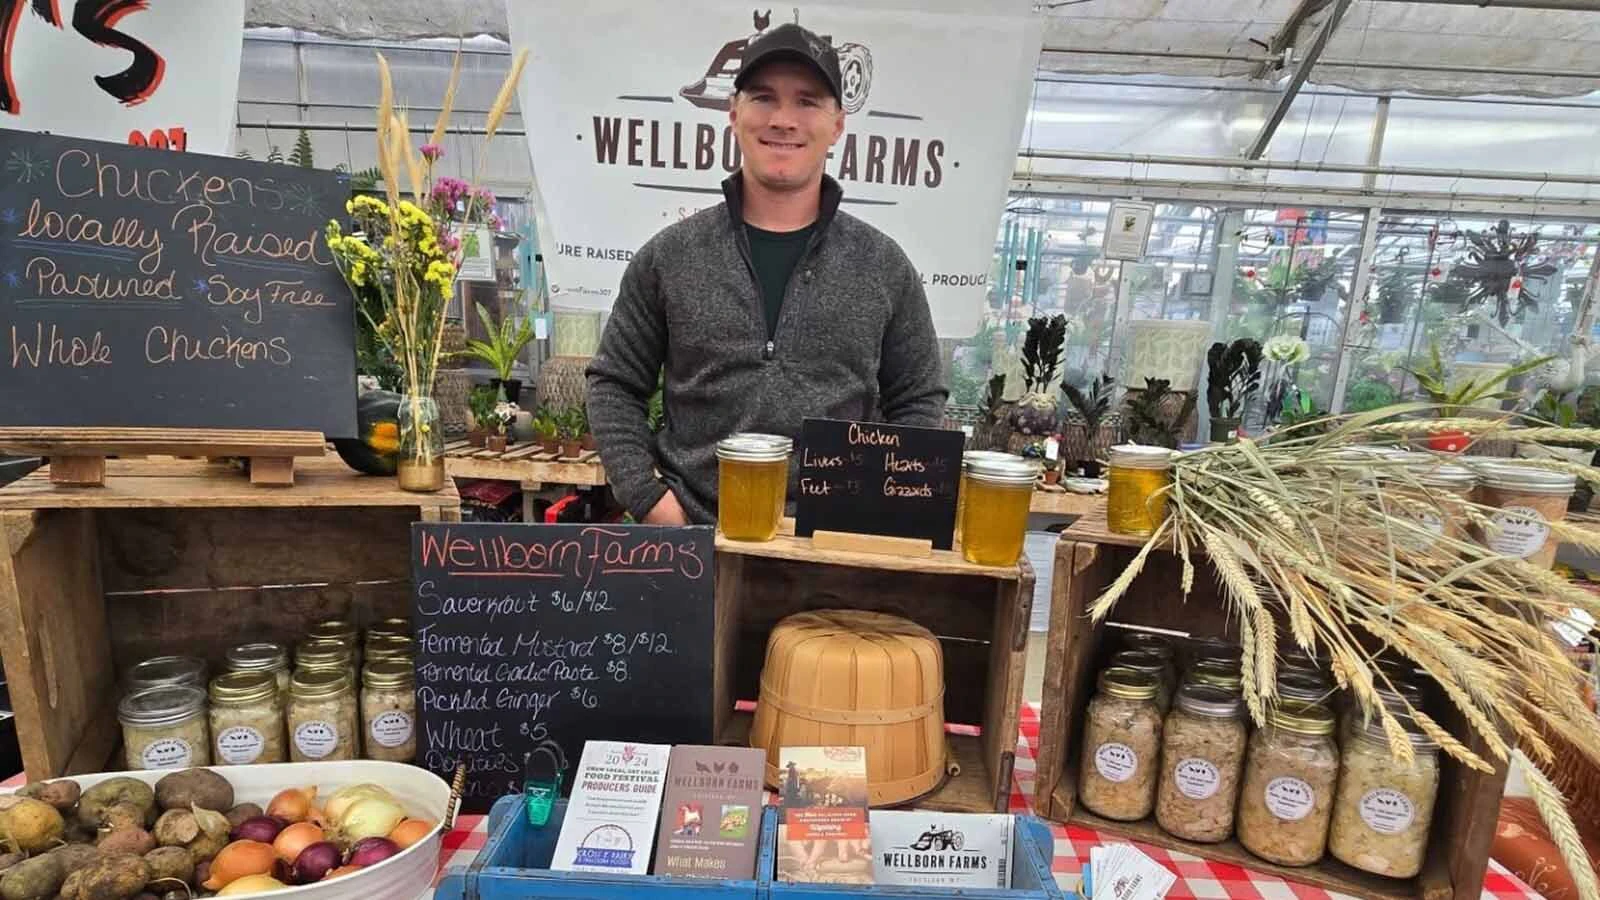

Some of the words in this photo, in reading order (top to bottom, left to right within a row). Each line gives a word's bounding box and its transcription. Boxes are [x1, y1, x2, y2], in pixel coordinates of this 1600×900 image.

[593, 116, 743, 173] WELLBO
[56, 149, 285, 210] Chickens
[18, 200, 164, 273] locally
[172, 204, 333, 266] Raised
[587, 246, 632, 263] RAISED
[11, 322, 112, 368] Whole
[145, 325, 292, 368] Chickens
[849, 423, 900, 447] Chicken
[421, 528, 583, 578] Wellborn
[582, 527, 704, 589] Farms
[418, 624, 505, 657] Fermented
[418, 687, 490, 712] Pickled
[496, 688, 560, 720] Ginger
[426, 720, 504, 750] Wheat
[581, 781, 630, 793] PRODUCERS
[633, 784, 658, 794] GUIDE
[584, 772, 611, 780] FOOD
[612, 774, 659, 783] FESTIVAL
[667, 855, 691, 869] What
[883, 853, 945, 868] WELLBORN
[949, 855, 988, 870] FARMS
